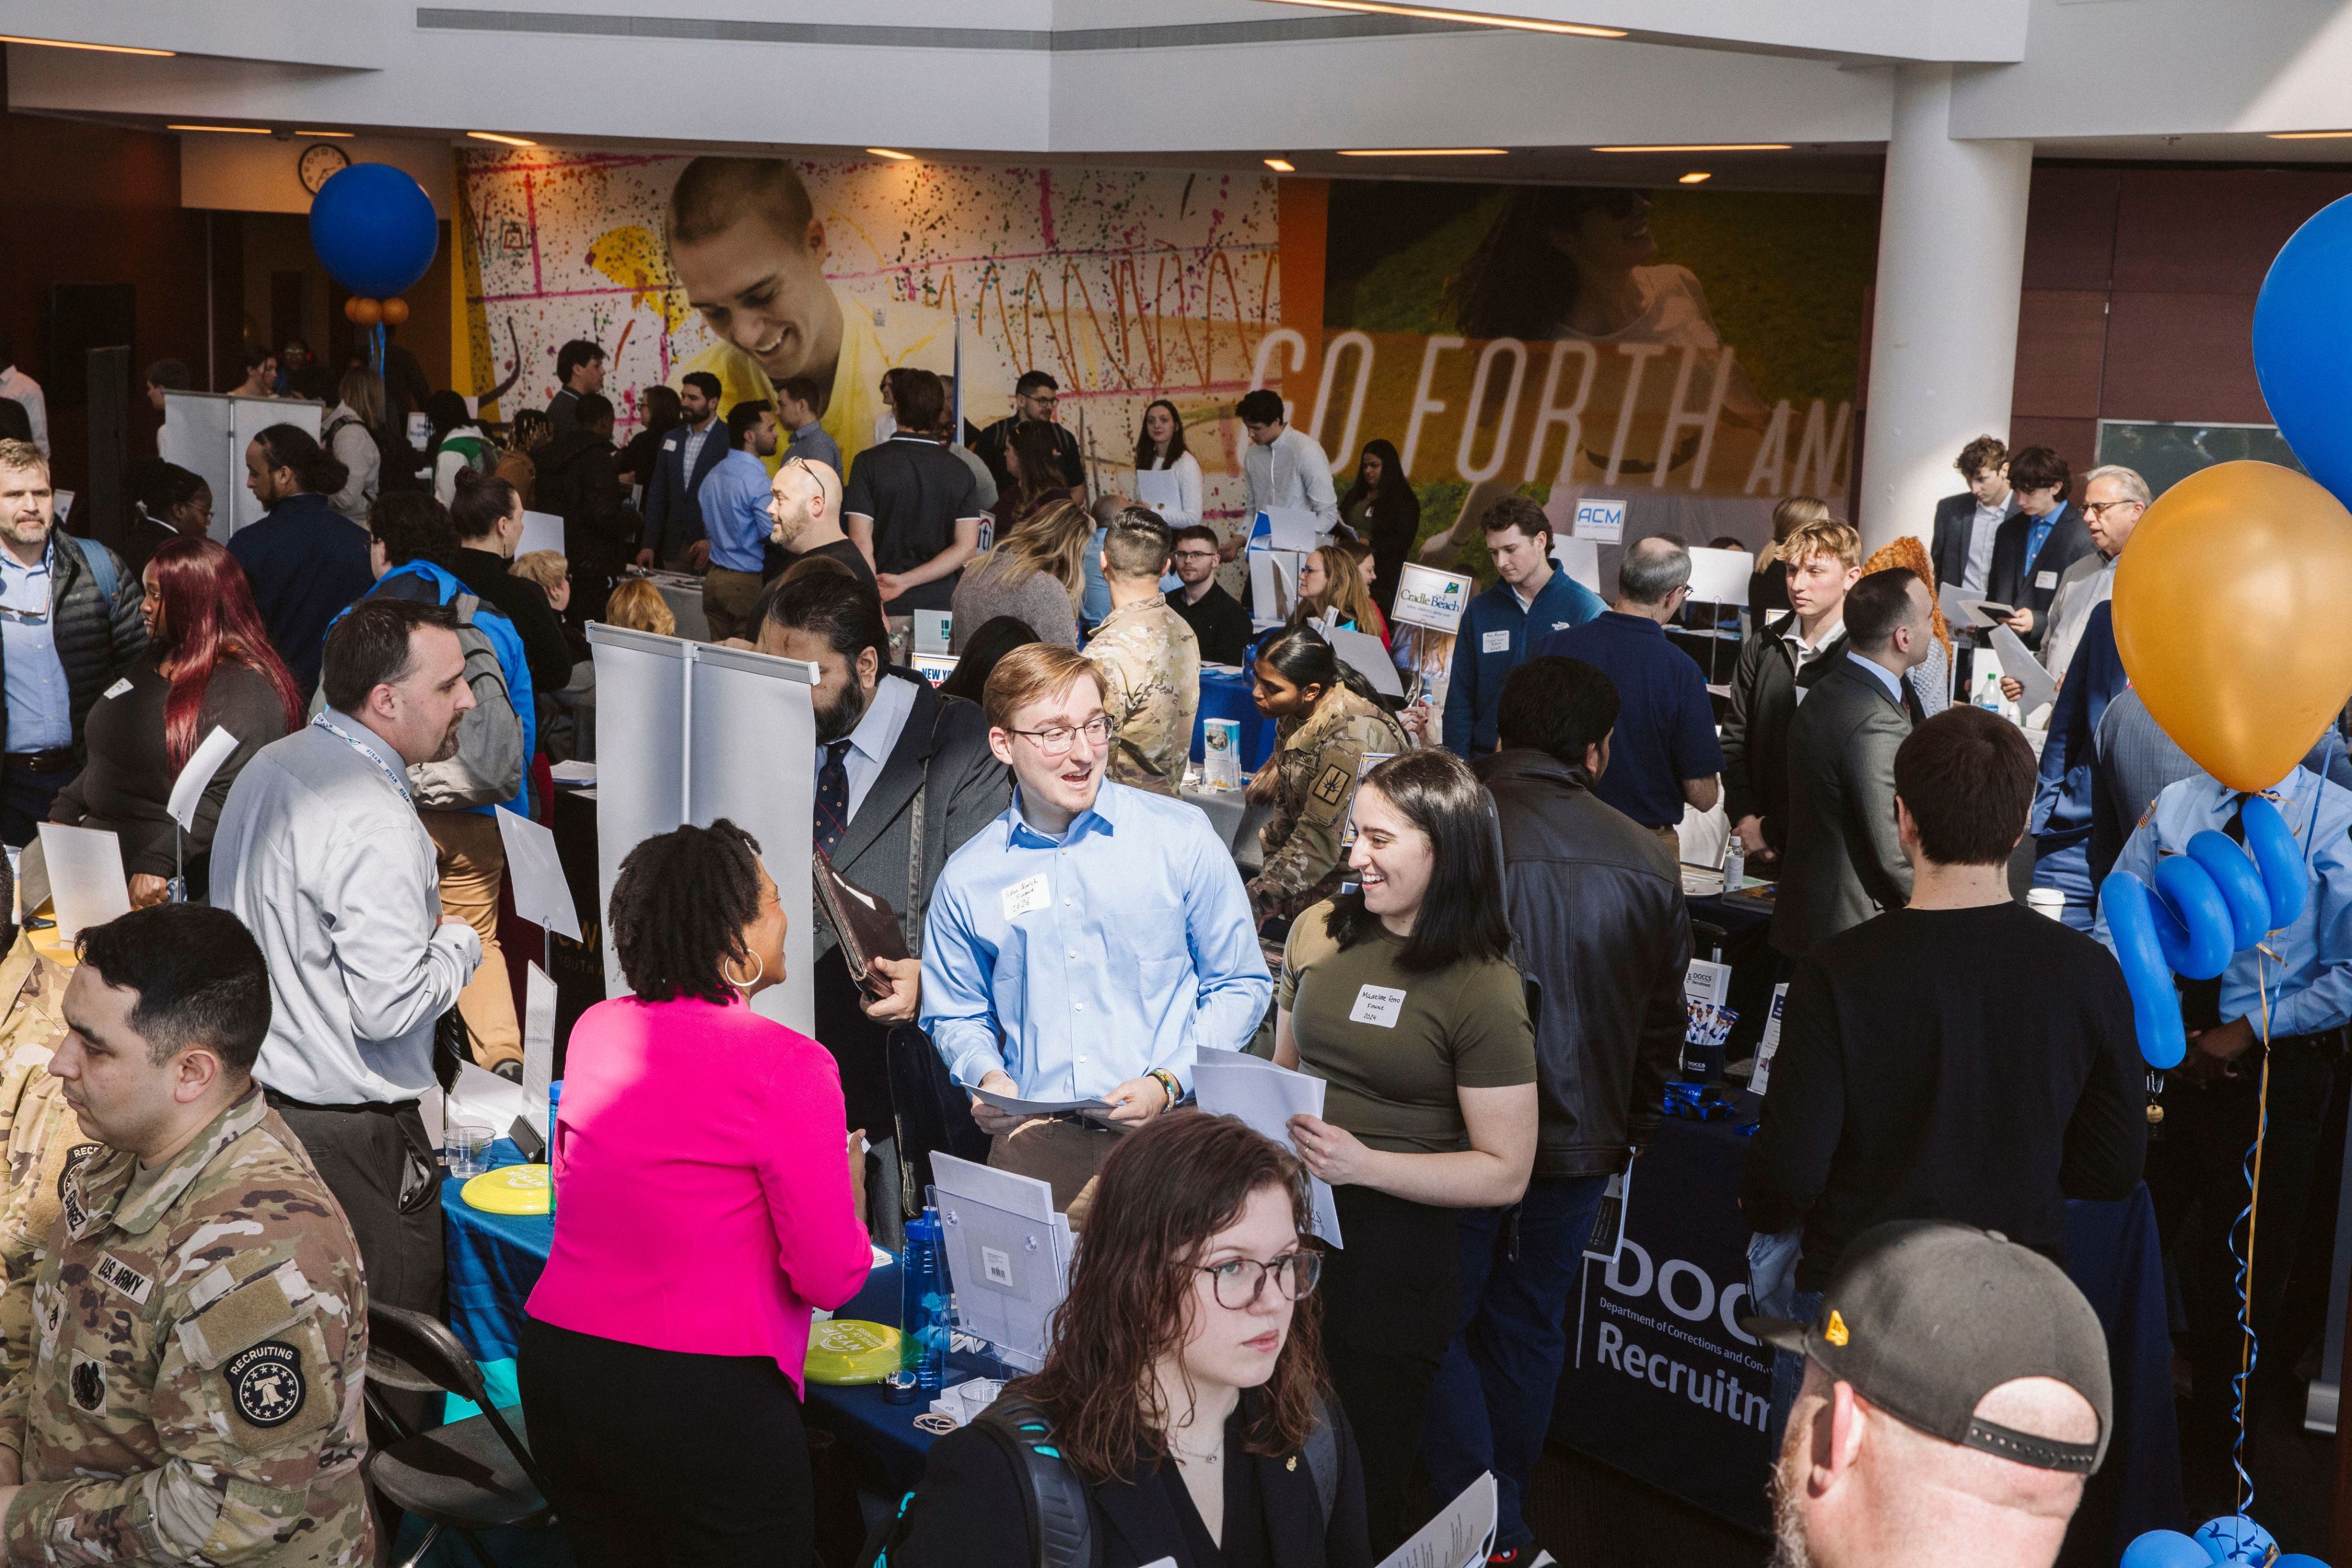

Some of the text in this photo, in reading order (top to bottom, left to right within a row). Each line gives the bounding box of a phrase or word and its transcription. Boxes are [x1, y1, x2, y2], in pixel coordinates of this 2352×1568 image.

[1401, 334, 1735, 491] FORTH
[1577, 508, 1622, 524] ACM
[1401, 589, 1460, 612] Cradle Beach
[922, 667, 941, 680] NEW
[366, 748, 382, 764] NYSIF
[384, 768, 398, 784] NYSIF
[1012, 897, 1030, 912] 2026
[1693, 972, 1712, 982] DOCCS
[1362, 992, 1401, 1003] Madeline Ferro
[1363, 1013, 1377, 1021] 2024
[98, 1257, 144, 1296] U.S. ARMY
[1600, 1296, 1655, 1329] Department
[1657, 1322, 1667, 1332] of
[1668, 1325, 1722, 1355] Corrections
[1724, 1348, 1742, 1364] and
[821, 1327, 864, 1352] NYSIF
[230, 1346, 293, 1376] RECRUITING
